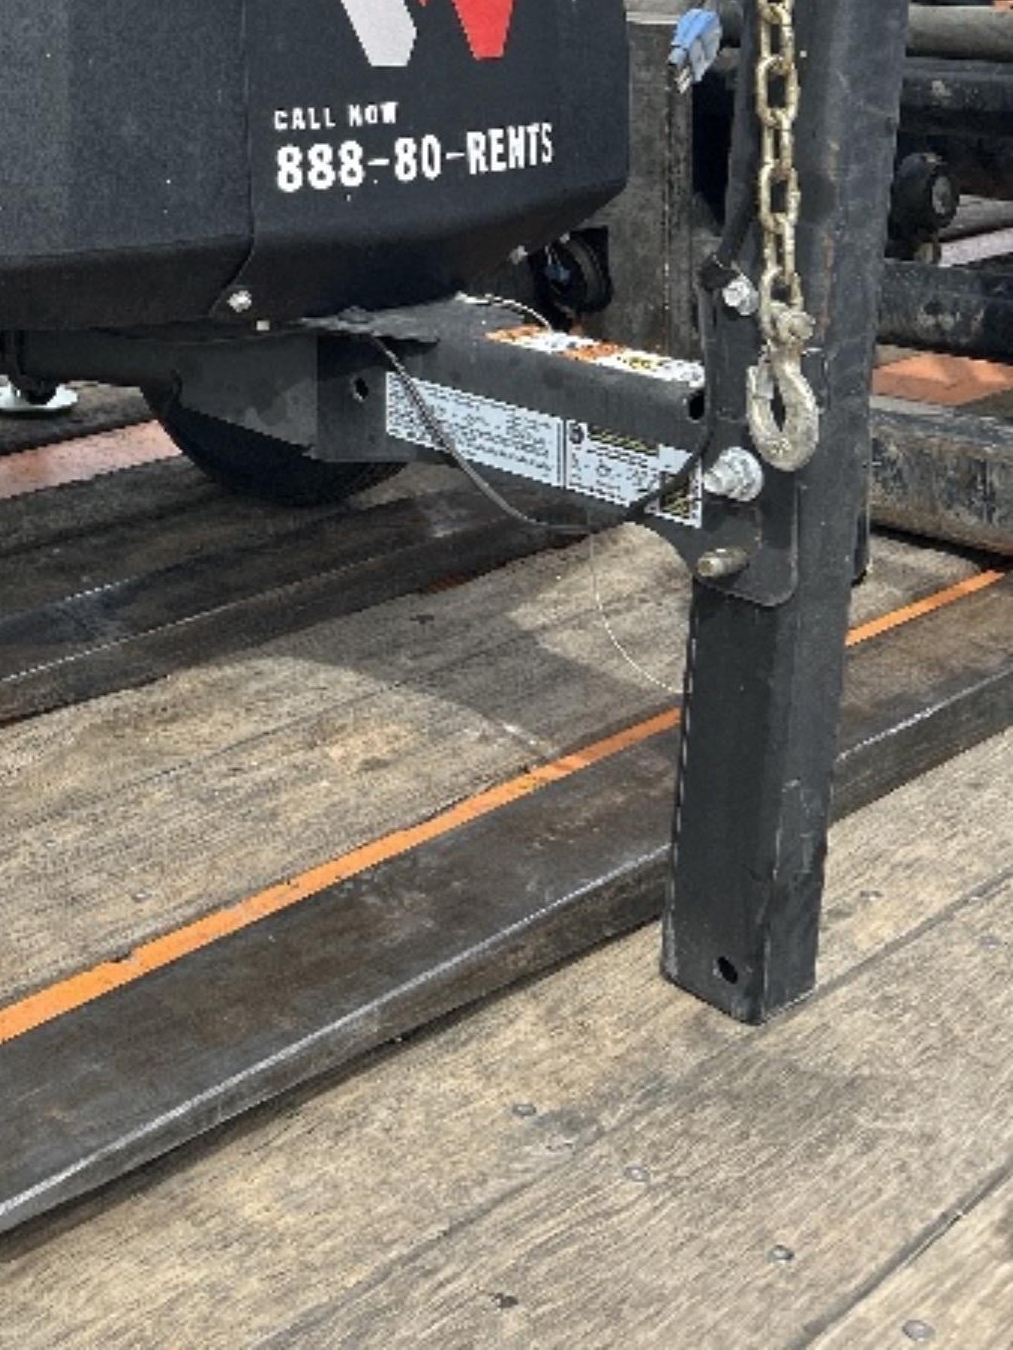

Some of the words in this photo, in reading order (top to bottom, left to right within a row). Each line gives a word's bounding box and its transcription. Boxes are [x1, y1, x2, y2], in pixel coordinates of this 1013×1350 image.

[274, 106, 336, 130] CALL
[348, 101, 399, 127] NOW
[276, 121, 553, 193] 888-80-RENTS
